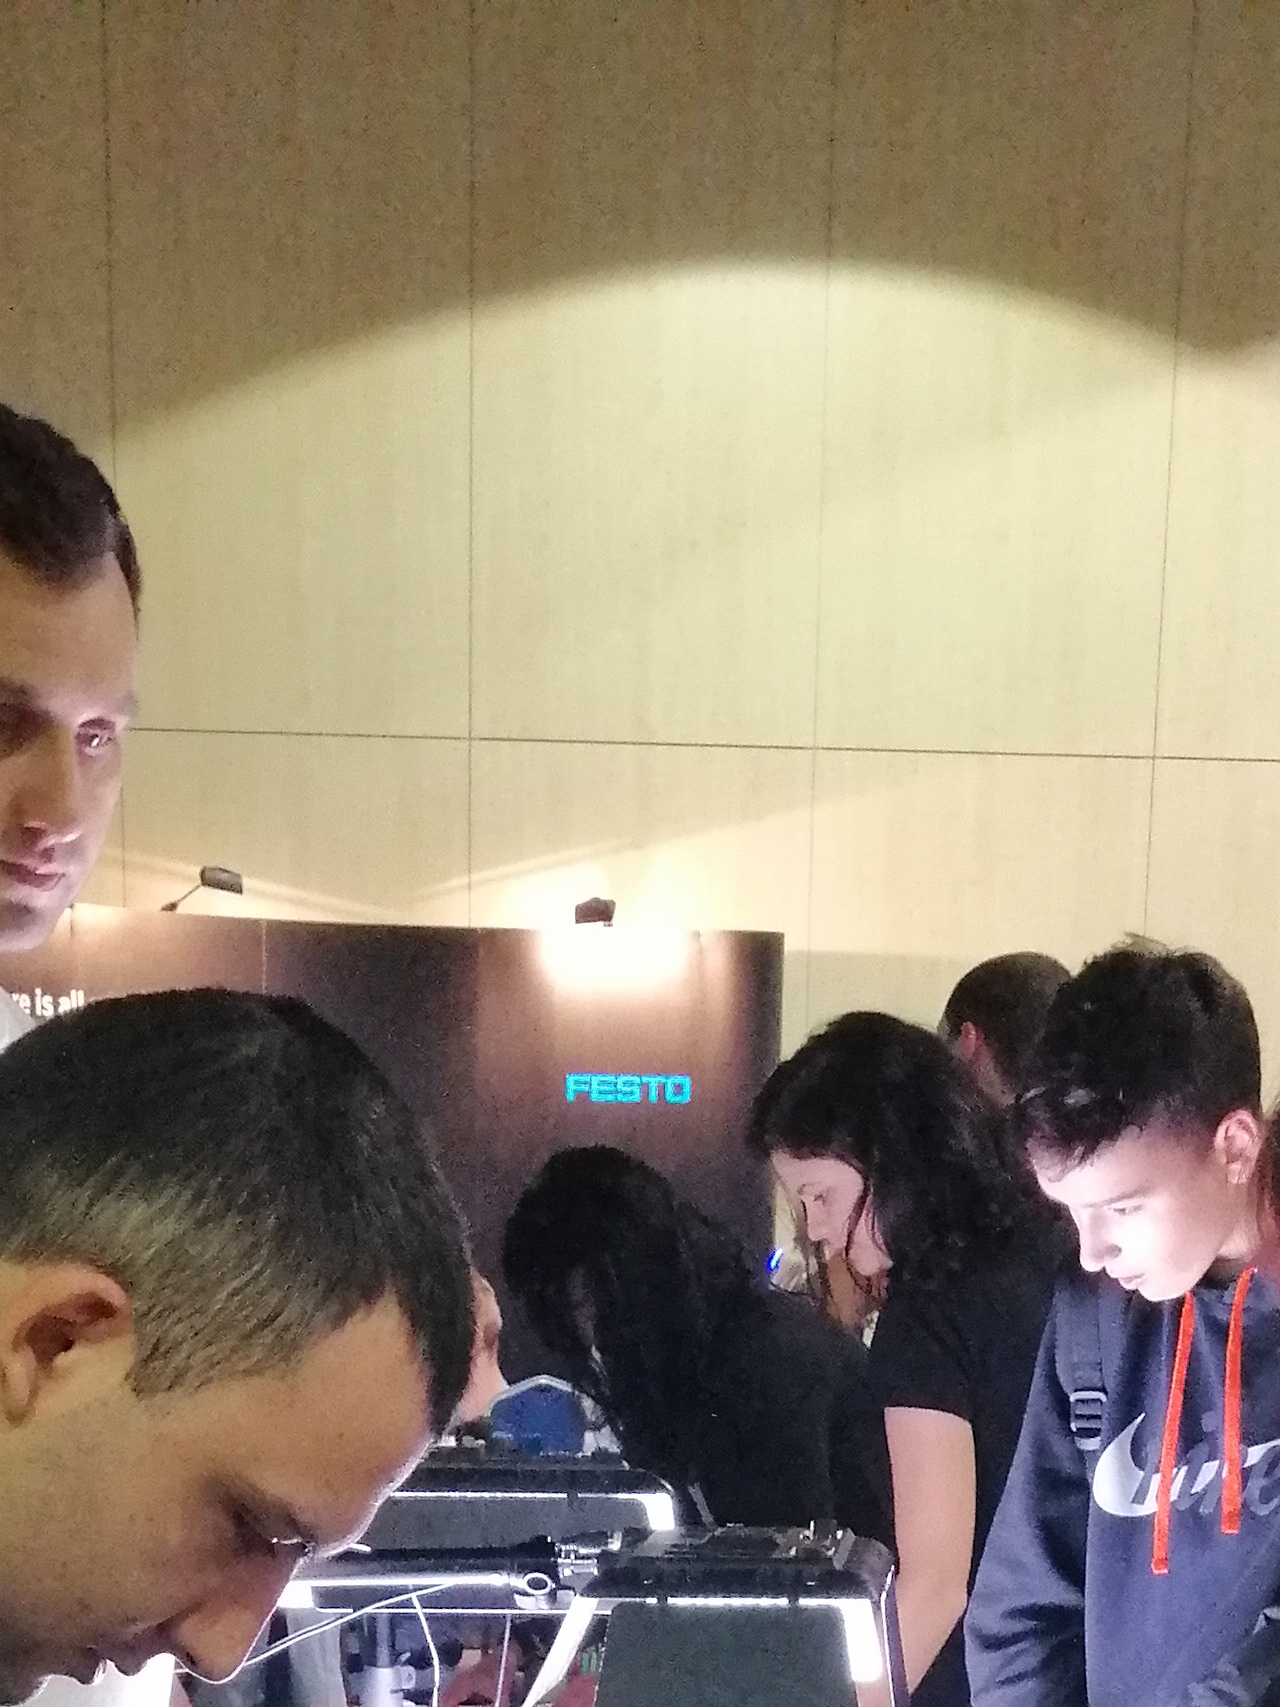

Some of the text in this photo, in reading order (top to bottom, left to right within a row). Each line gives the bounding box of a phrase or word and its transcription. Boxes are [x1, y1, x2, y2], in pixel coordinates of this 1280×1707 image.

[35, 987, 55, 1017] is
[58, 988, 85, 1014] all
[565, 1073, 692, 1104] FESTO
